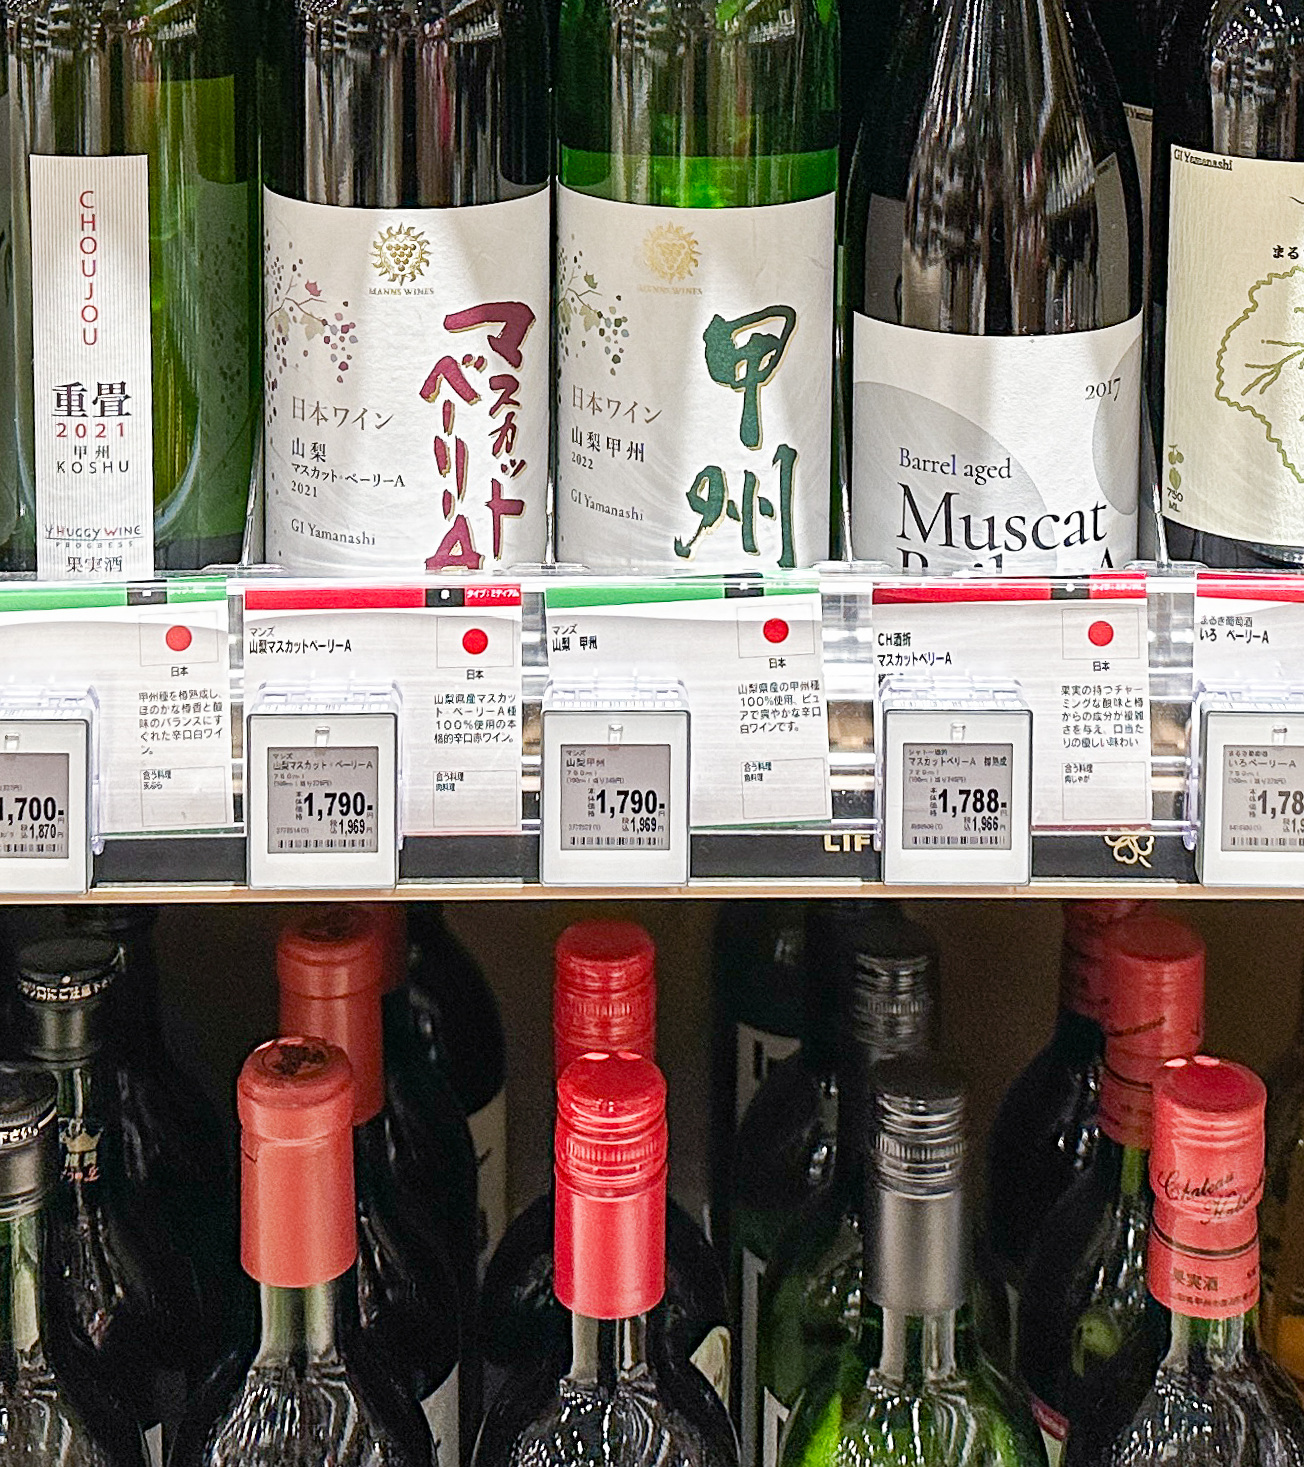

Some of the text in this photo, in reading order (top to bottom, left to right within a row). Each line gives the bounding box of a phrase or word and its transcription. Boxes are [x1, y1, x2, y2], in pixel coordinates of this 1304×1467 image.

[79, 190, 98, 346] CHOUJOU
[52, 381, 132, 419] 重畳
[1085, 378, 1121, 401] 2017
[291, 396, 394, 431] 日本ワイン
[572, 384, 663, 424] 日本ワイン
[56, 422, 125, 439] 2021
[485, 301, 536, 560] マスカット
[674, 304, 798, 569] 甲州
[73, 445, 111, 459] 甲州
[291, 437, 327, 463] 山梨
[572, 427, 645, 463] 山梨甲州
[56, 460, 130, 474] KOSHU
[419, 354, 484, 571] ベーリーA
[572, 452, 594, 470] 2022
[898, 447, 1013, 486] Barrel aged
[291, 480, 318, 498] 2021
[896, 482, 1107, 551] Muscat
[66, 556, 123, 573] 果実酒
[249, 627, 275, 637] マンズ
[1200, 628, 1269, 644] いろ ベーリーA
[249, 639, 352, 654] 山梨マスカットベーリーA
[877, 652, 952, 667] マスカットベリーA
[303, 792, 365, 821] 1,790
[596, 789, 657, 818] 1,790
[938, 789, 999, 817] 1,788
[1171, 1268, 1219, 1291] 果実酒
